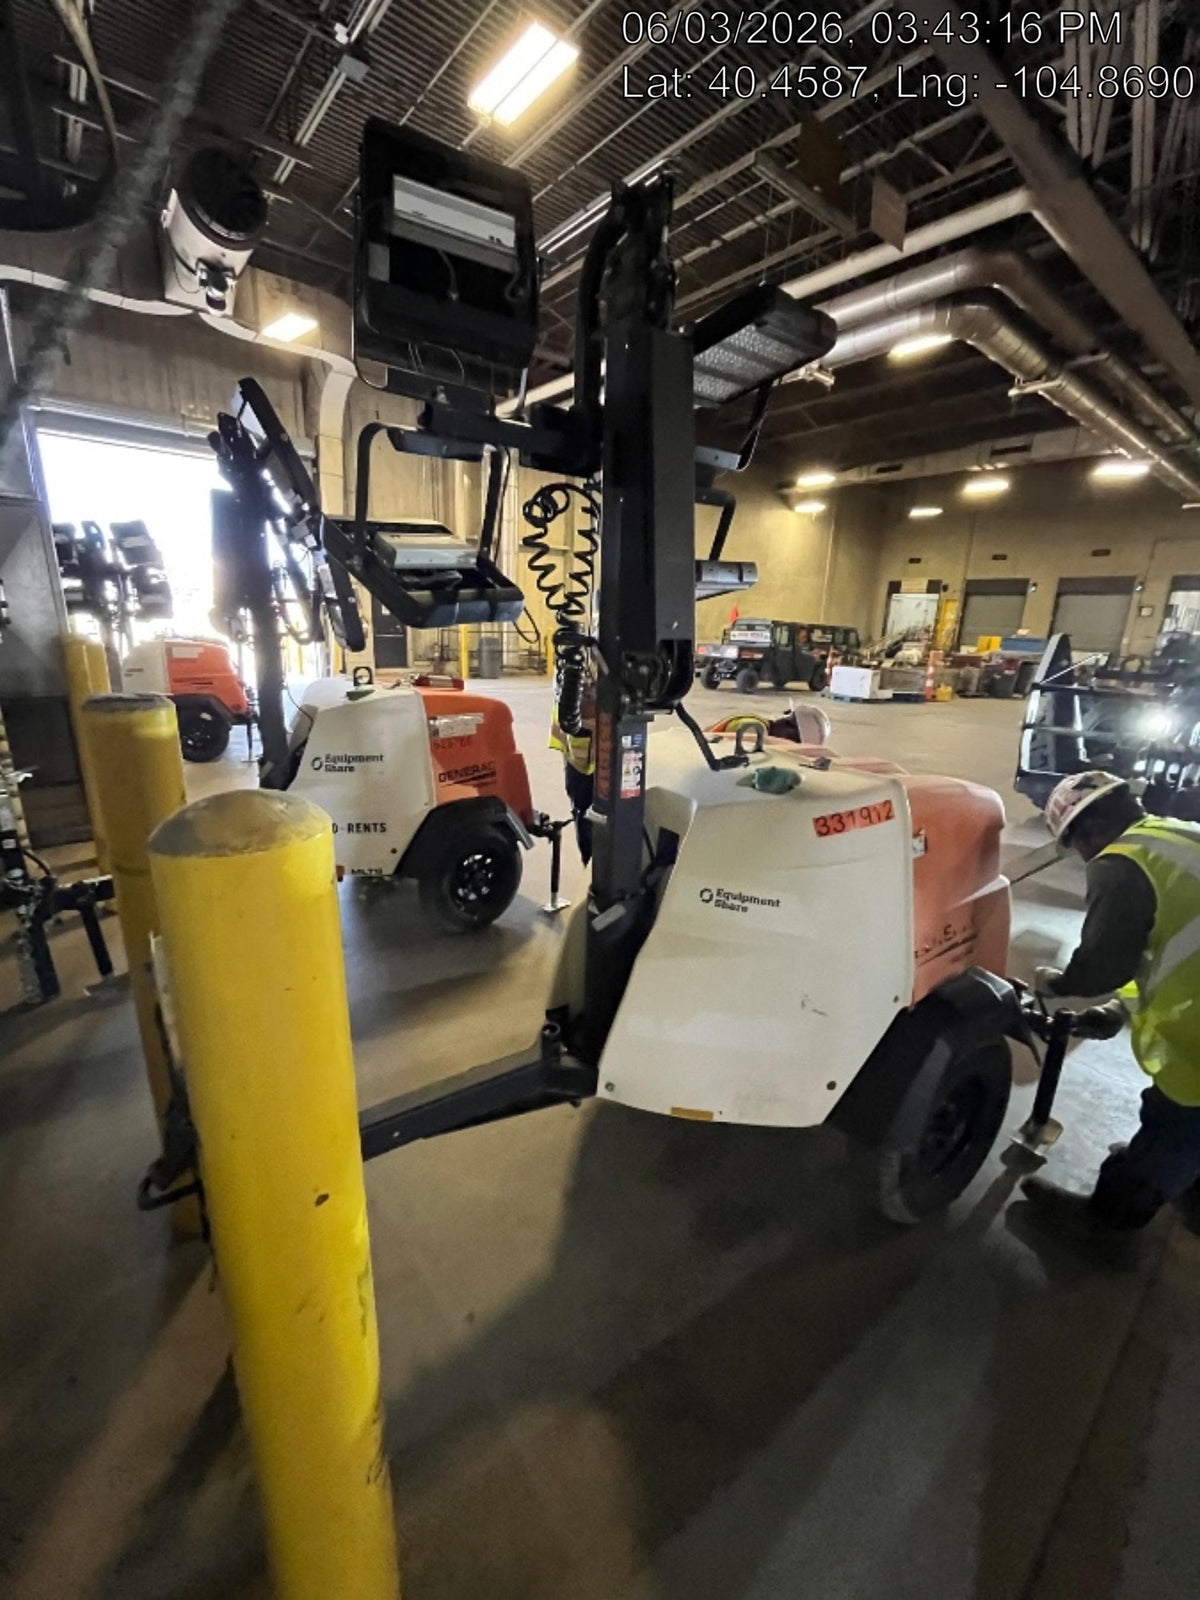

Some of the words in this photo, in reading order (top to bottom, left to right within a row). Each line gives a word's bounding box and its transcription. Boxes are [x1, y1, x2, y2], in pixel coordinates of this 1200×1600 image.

[325, 754, 384, 764] Equipment
[815, 800, 893, 836] 331912
[716, 888, 781, 907] Equipment
